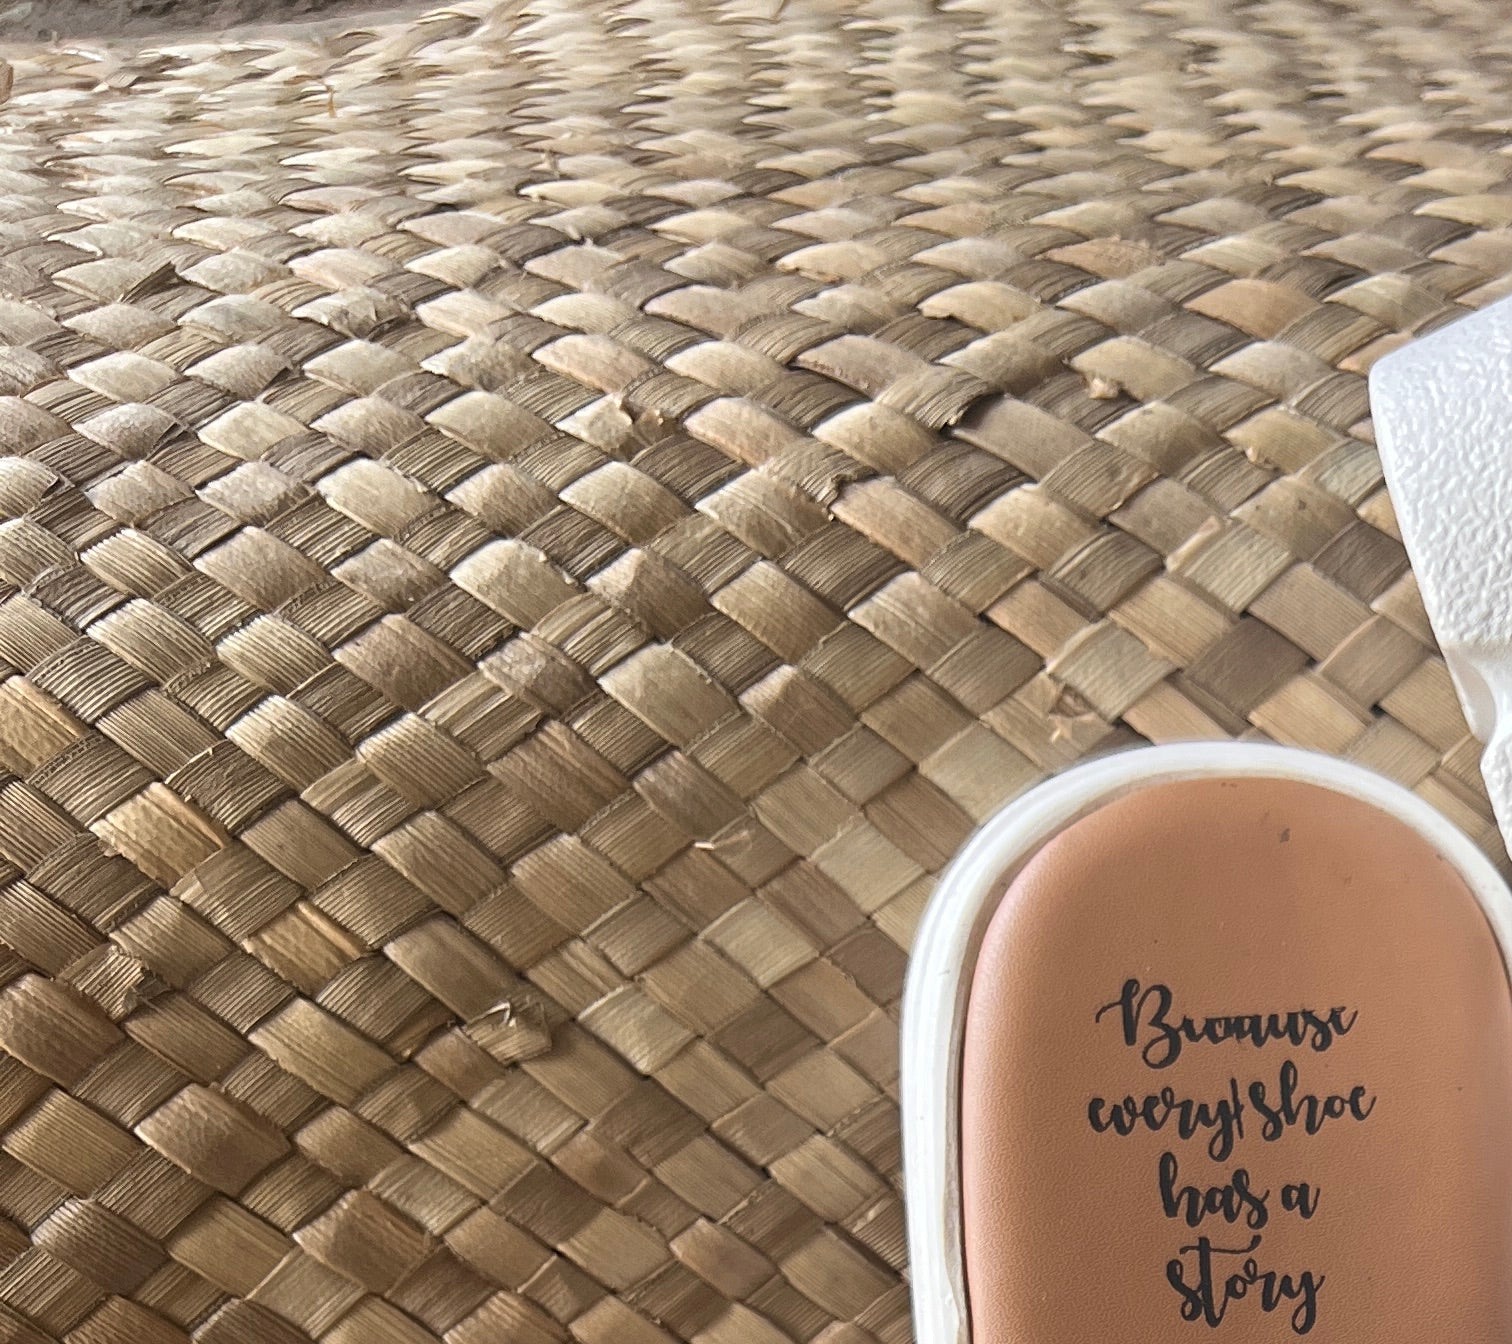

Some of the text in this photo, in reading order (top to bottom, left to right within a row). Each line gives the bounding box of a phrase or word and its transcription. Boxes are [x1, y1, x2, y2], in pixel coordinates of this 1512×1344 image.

[1247, 1060, 1377, 1142] shoe
[1158, 1151, 1321, 1230] has a
[1166, 1234, 1326, 1335] story
